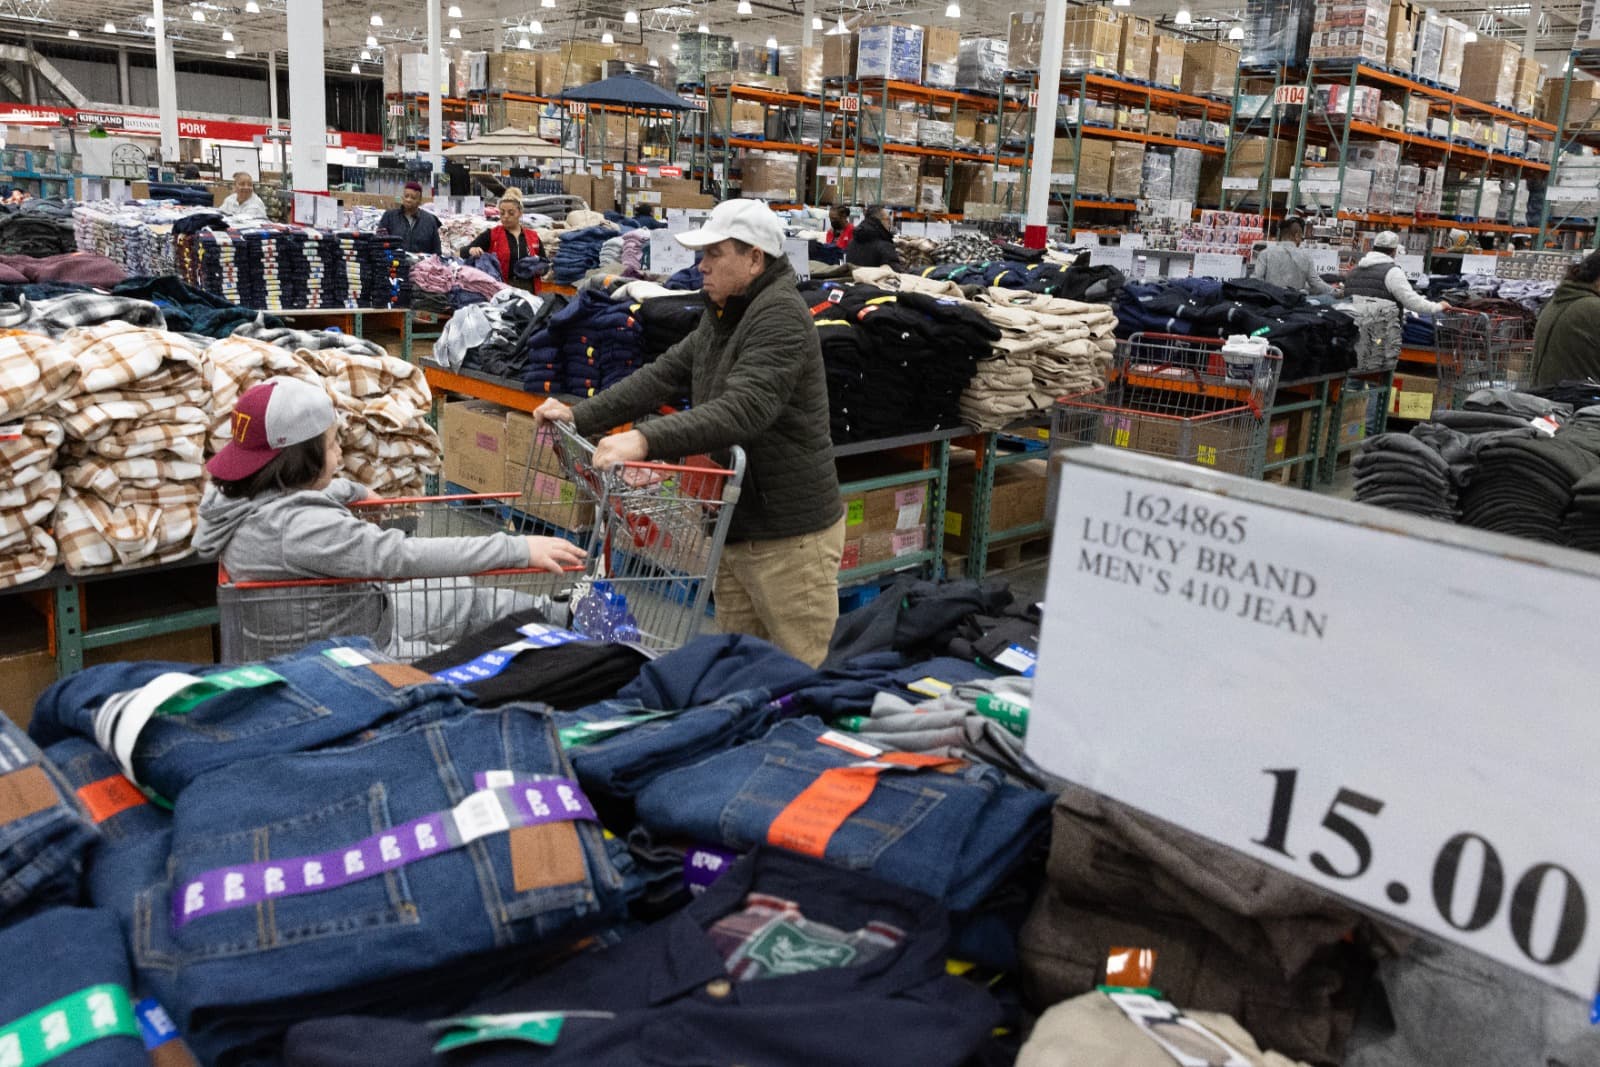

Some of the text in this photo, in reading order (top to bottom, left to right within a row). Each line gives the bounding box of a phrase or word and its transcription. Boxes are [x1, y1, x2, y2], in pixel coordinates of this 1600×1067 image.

[79, 114, 122, 125] KIRKLAND
[570, 103, 585, 113] 112
[842, 97, 857, 110] 108
[180, 122, 206, 134] PORK
[1122, 490, 1248, 544] 1624865
[1083, 517, 1318, 600] LUCKY BRAND
[1077, 548, 1329, 639] MEN'S 410 JEAN
[1250, 768, 1588, 966] 15.00
